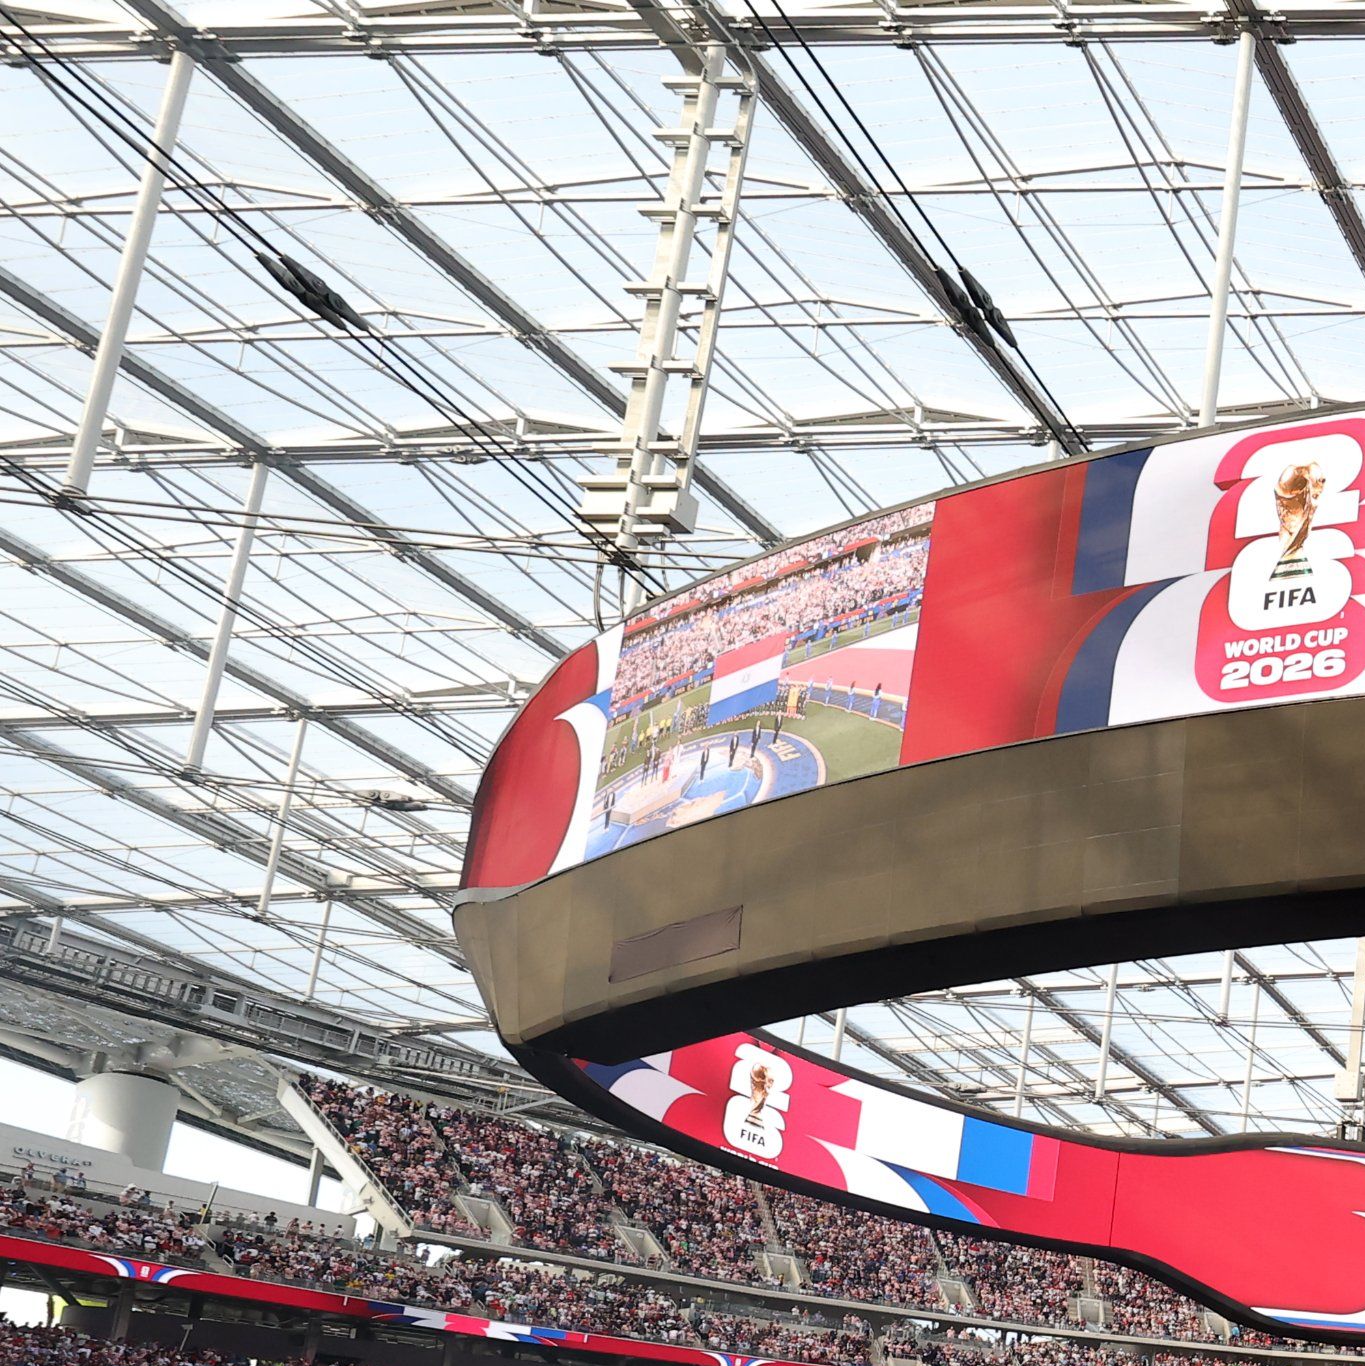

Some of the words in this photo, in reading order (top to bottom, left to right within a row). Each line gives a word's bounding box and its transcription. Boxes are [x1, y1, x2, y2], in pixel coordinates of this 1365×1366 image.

[1263, 587, 1317, 610] FIFA
[1224, 632, 1302, 659] WORLD
[1303, 627, 1348, 648] CUP
[1219, 648, 1346, 690] 2026
[740, 1129, 766, 1147] FIFA
